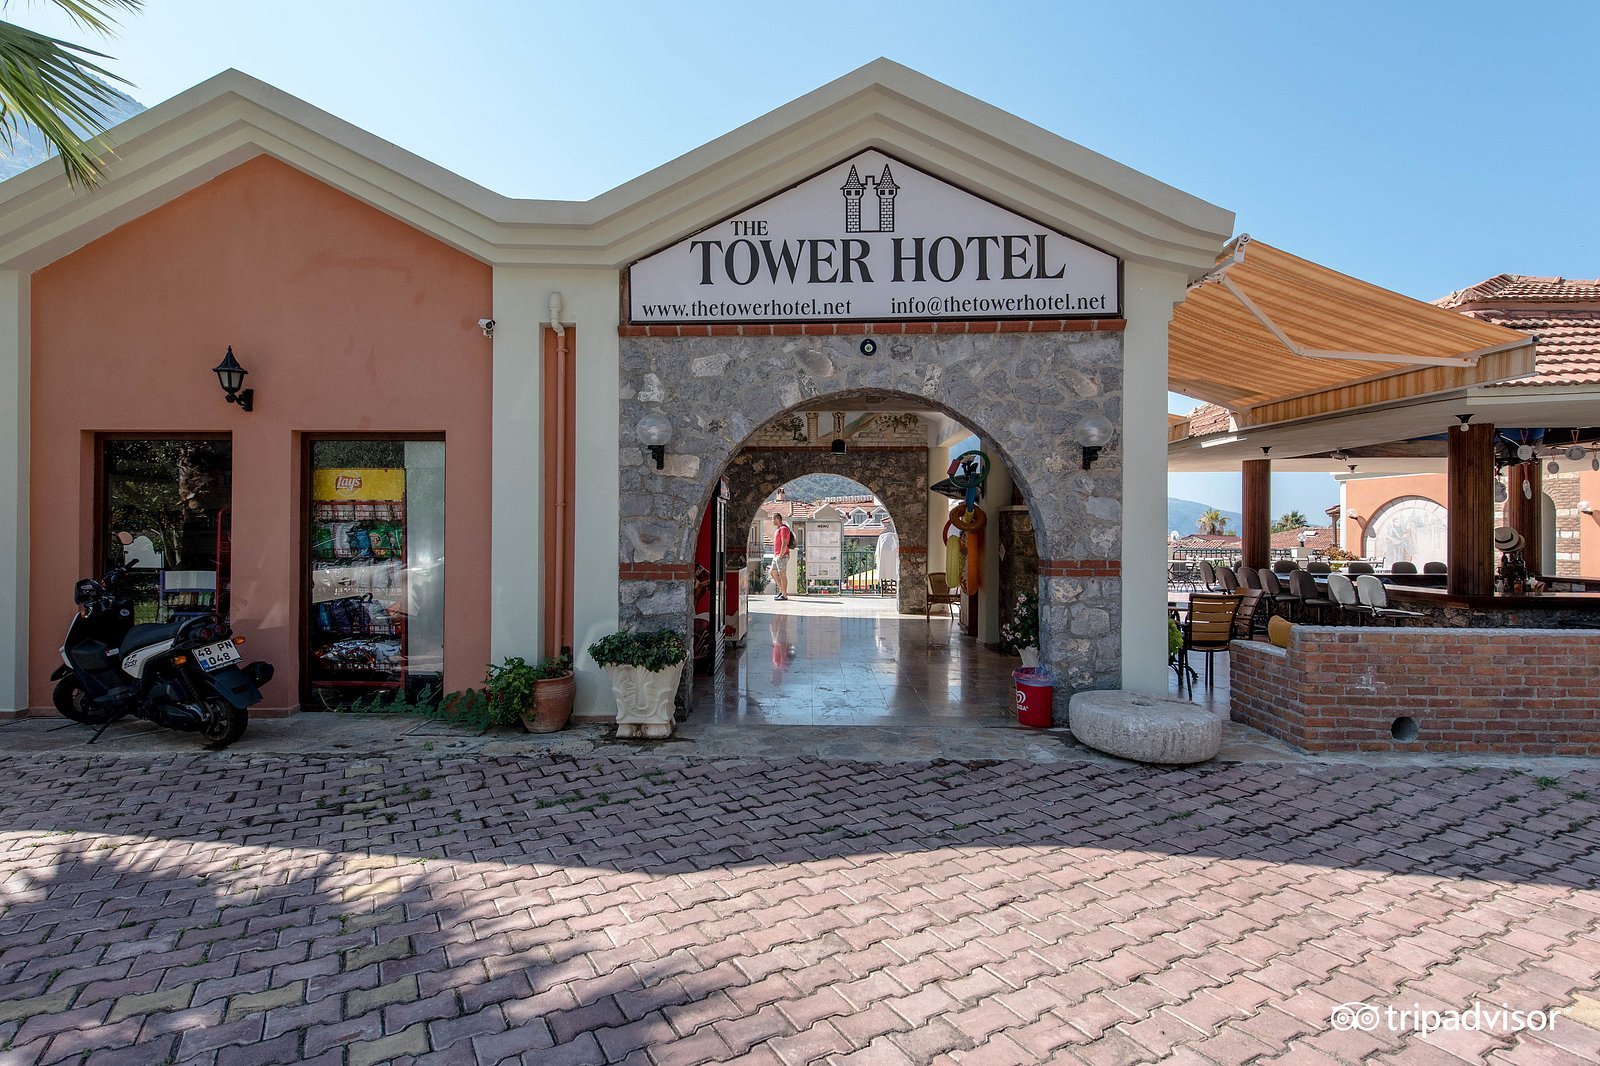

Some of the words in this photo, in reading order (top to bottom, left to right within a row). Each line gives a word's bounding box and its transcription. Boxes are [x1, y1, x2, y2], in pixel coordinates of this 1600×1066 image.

[730, 220, 769, 236] THE
[689, 238, 875, 285] TOWER
[890, 234, 1067, 283] HOTEL
[642, 298, 852, 318] www.thetowerhotel.net
[891, 293, 1106, 316] info@thetowerhotel.net
[197, 647, 212, 657] 48
[217, 640, 233, 652] PN
[208, 652, 231, 665] 048
